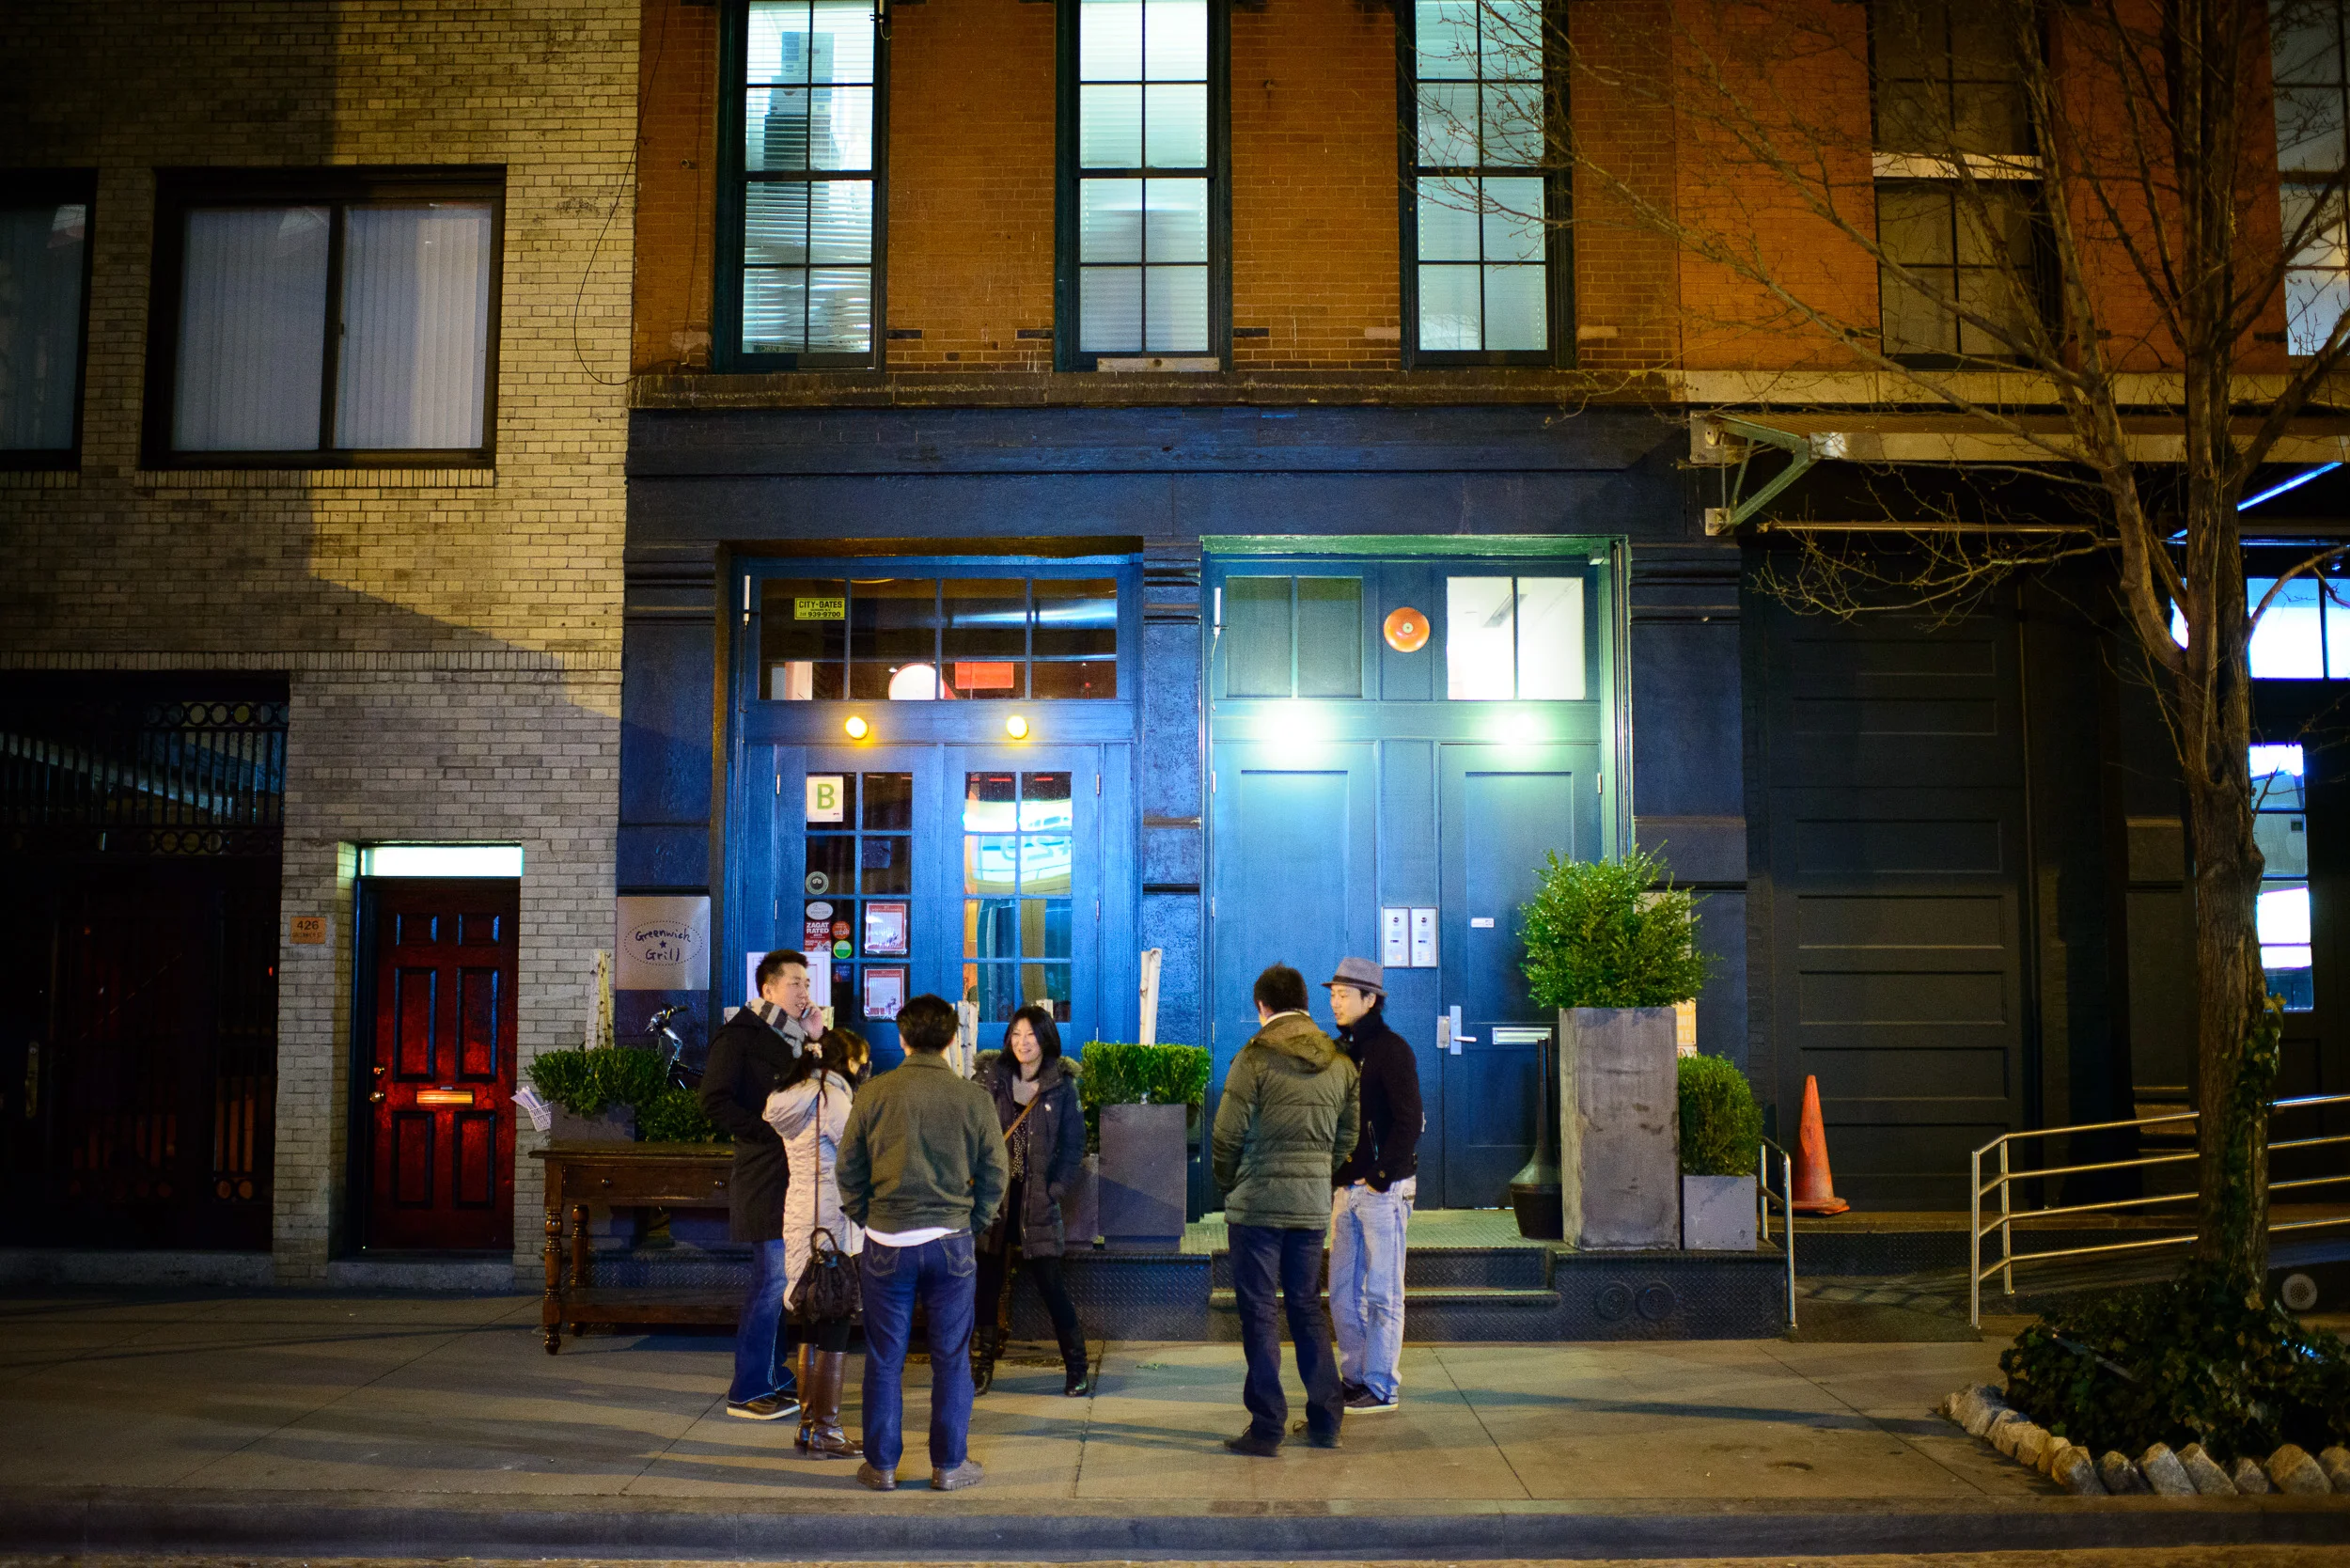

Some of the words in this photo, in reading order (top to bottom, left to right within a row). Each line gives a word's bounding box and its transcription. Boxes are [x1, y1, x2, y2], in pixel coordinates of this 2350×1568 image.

[816, 783, 836, 810] B
[296, 920, 320, 930] 426
[634, 928, 691, 943] Greenwich
[645, 948, 681, 962] Grill
